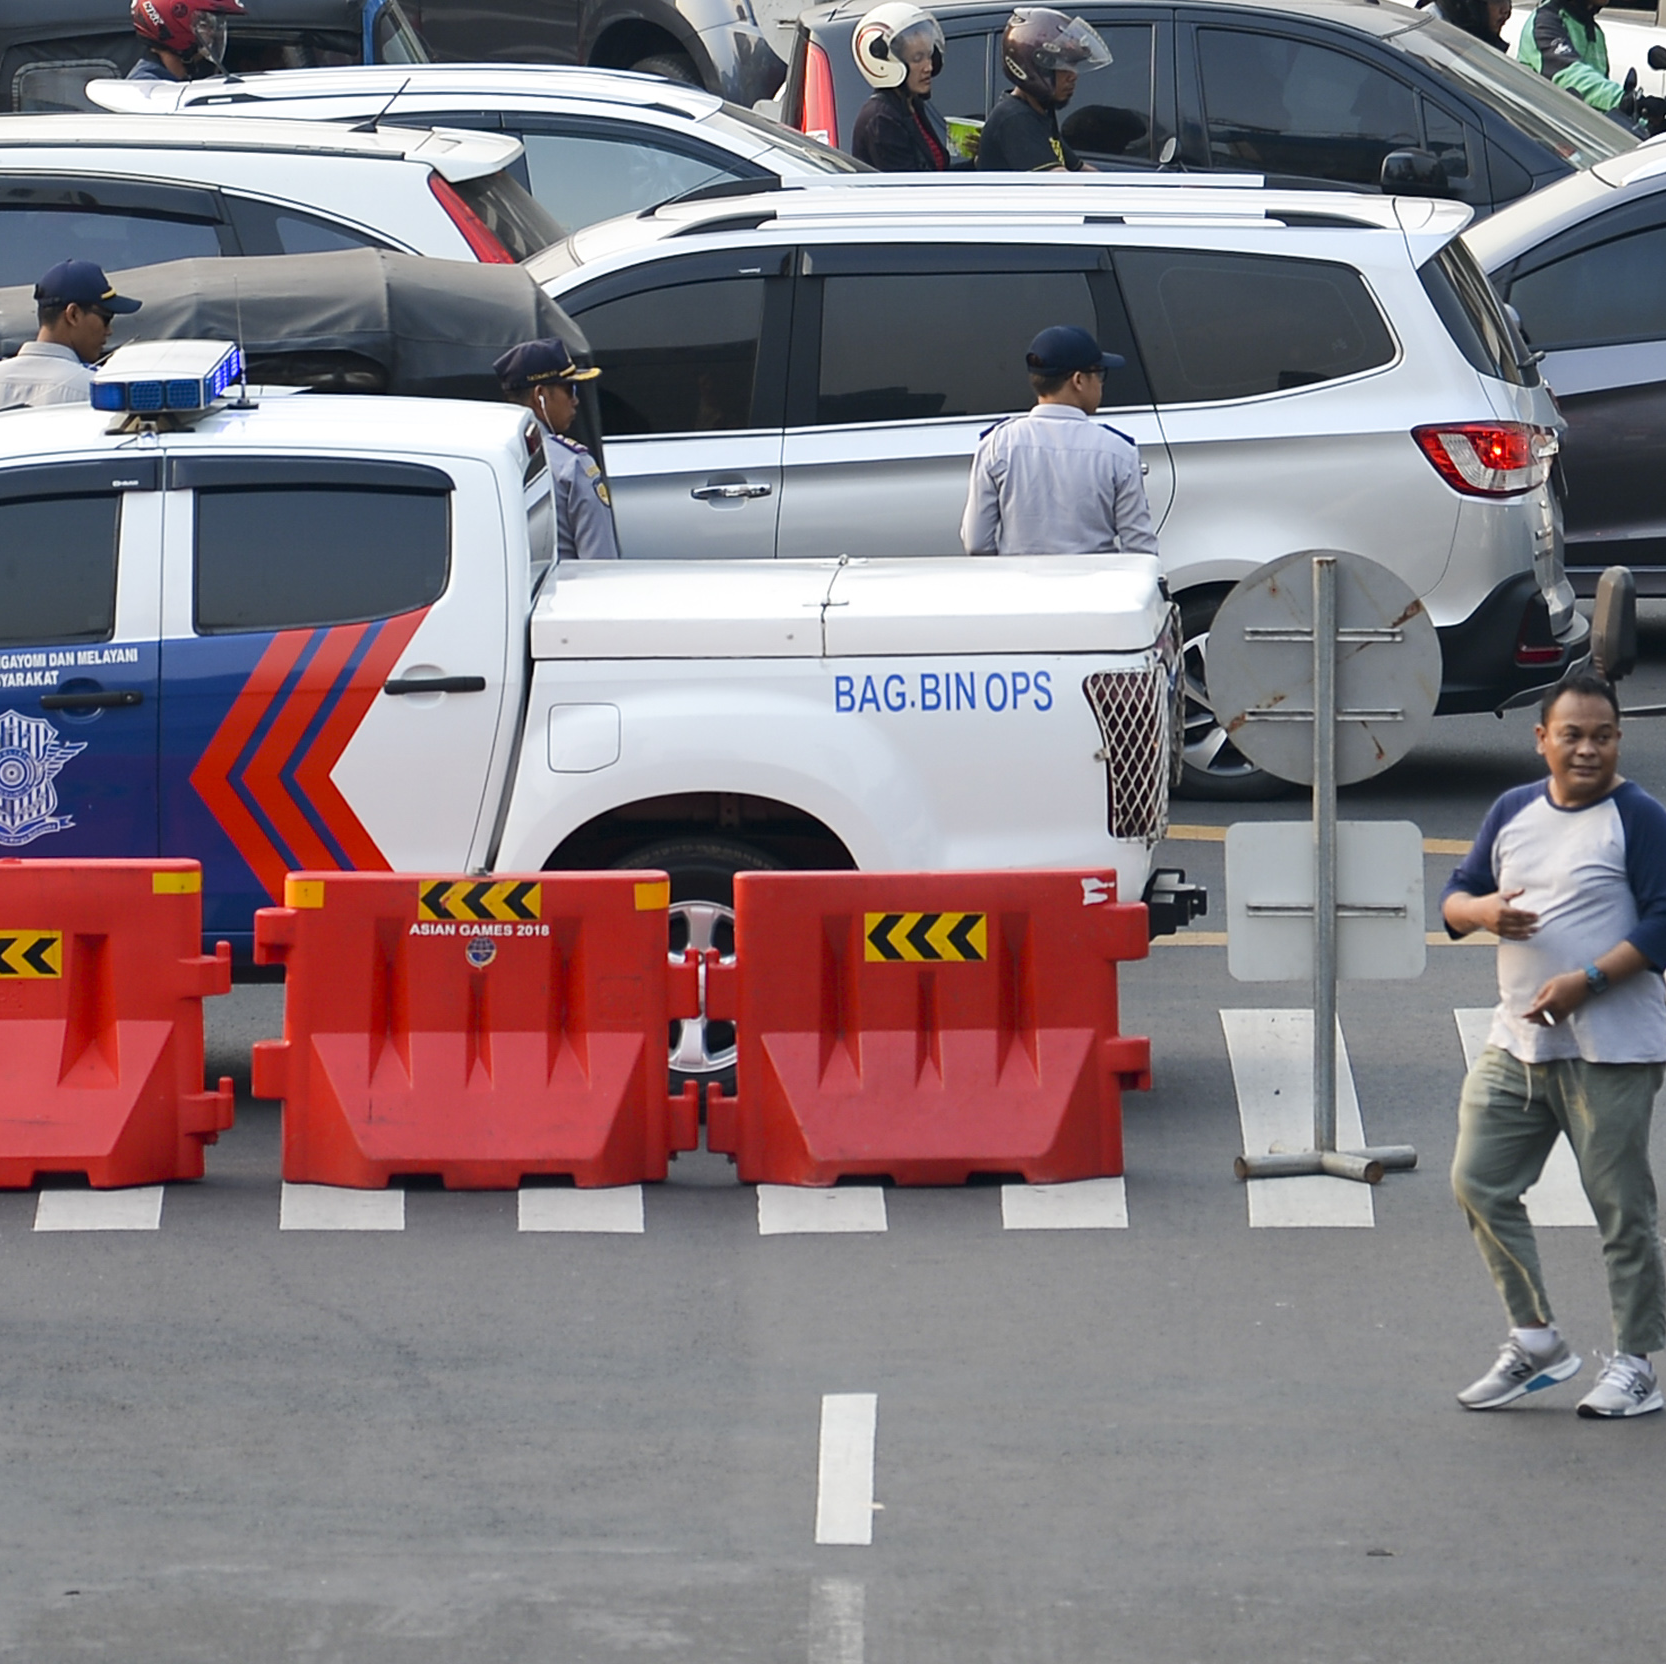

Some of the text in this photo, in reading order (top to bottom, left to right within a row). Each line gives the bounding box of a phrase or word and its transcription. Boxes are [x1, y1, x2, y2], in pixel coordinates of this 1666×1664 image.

[49, 650, 74, 667] DAN
[77, 647, 138, 665] MELAYANI
[985, 670, 1053, 712] OPS
[409, 924, 550, 936] ASIAN GAMES 2018
